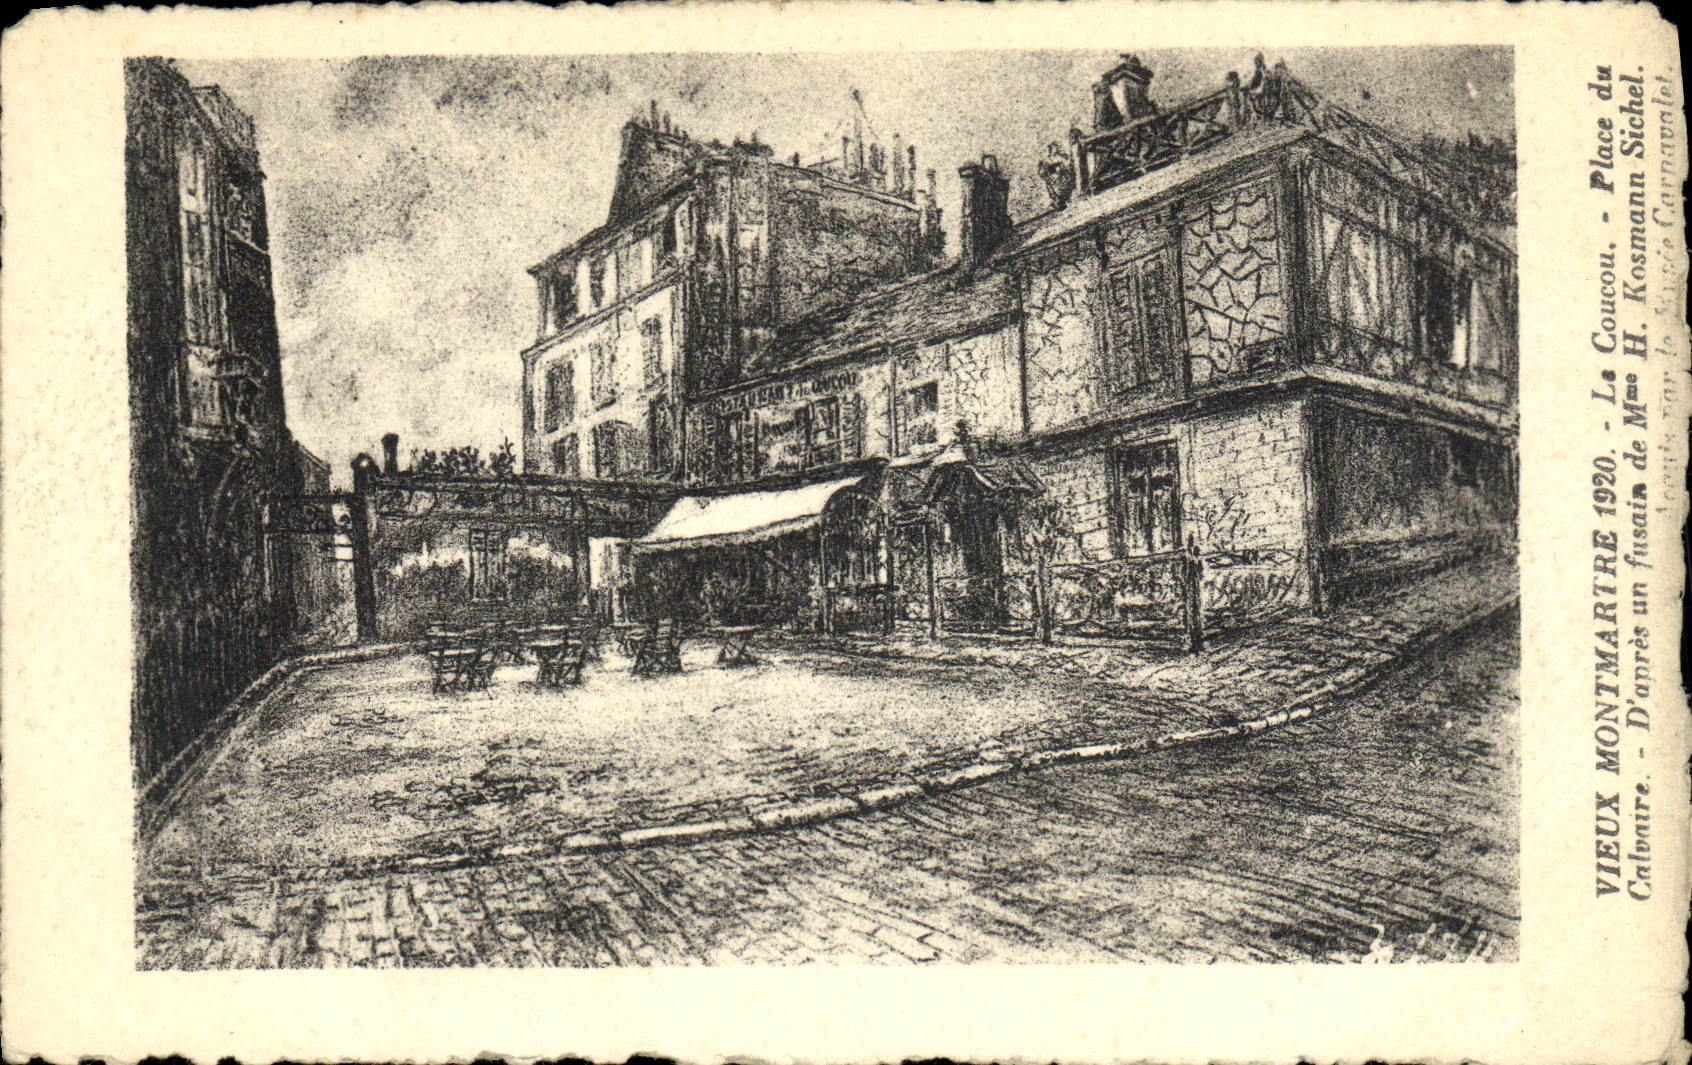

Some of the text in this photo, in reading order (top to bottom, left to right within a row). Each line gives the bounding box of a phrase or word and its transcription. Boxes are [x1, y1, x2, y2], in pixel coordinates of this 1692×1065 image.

[1588, 65, 1612, 100] du
[1619, 66, 1644, 159] Sichel.
[1589, 118, 1614, 193] Place
[1651, 67, 1675, 227] Carnavalet.
[1623, 172, 1646, 302] Kosmann
[1592, 243, 1616, 353] Coucou.
[1623, 324, 1647, 360] H.
[1592, 370, 1616, 405] Le
[1592, 450, 1616, 516] 1920.
[1623, 441, 1647, 470] de
[1624, 483, 1652, 568] fusain
[1633, 583, 1647, 614] un
[1593, 530, 1619, 775] MONTMARTRE
[1625, 626, 1656, 732] D'après
[1596, 792, 1620, 897] VIEUX
[1627, 774, 1651, 901] Calvaire.
